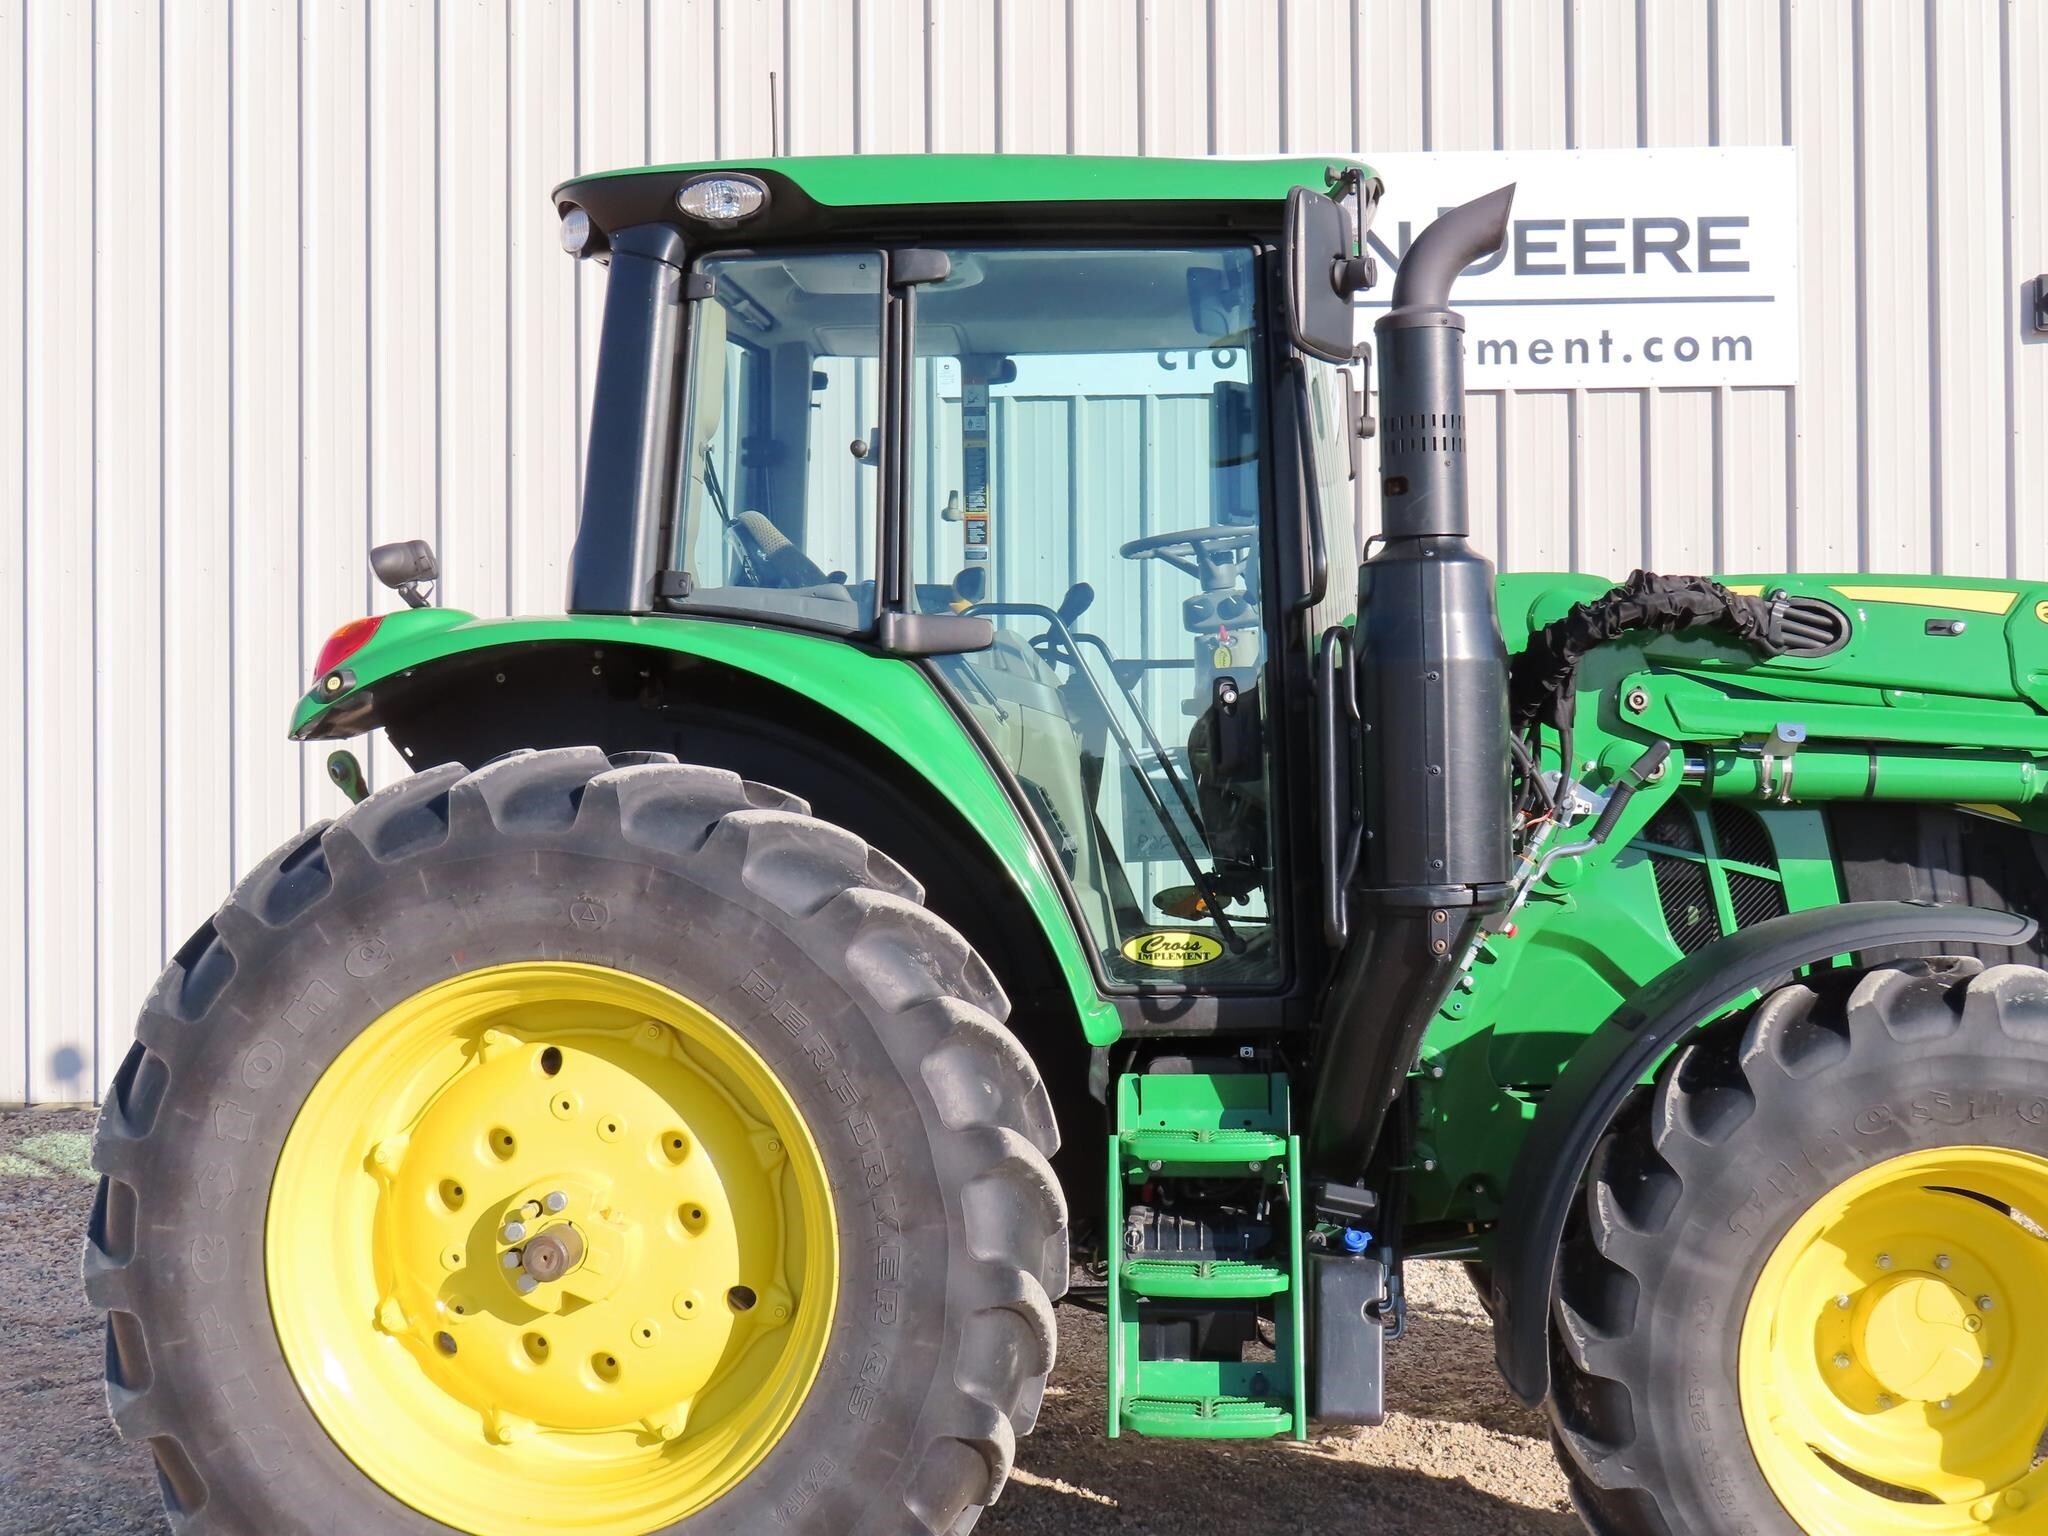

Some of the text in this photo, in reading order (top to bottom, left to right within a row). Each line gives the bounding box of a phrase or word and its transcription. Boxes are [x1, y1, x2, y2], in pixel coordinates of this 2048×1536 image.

[1137, 951, 1211, 961] IMPLEMENT
[1141, 935, 1202, 954] Cross
[739, 968, 902, 1326] PERFORMER
[769, 1455, 839, 1529] EXTRA
